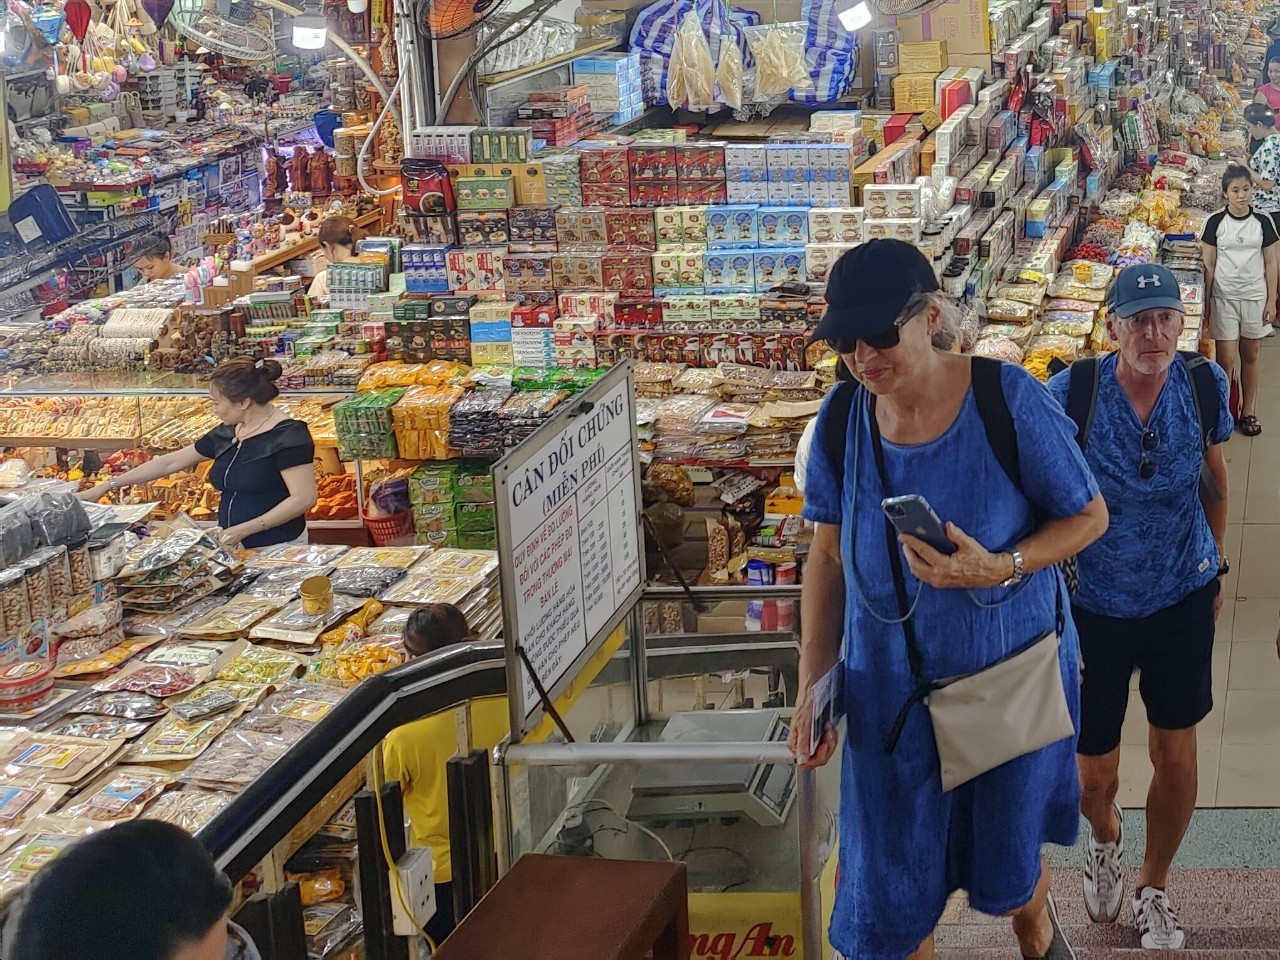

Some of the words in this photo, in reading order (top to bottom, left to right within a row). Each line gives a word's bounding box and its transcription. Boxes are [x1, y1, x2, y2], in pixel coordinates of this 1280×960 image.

[512, 467, 545, 507] CÂN
[549, 429, 574, 478] ĐỐI
[578, 394, 624, 450] CHỨNG
[542, 469, 579, 517] (MIỄN
[582, 442, 605, 479] PHÍ)
[523, 580, 542, 604] TRONG
